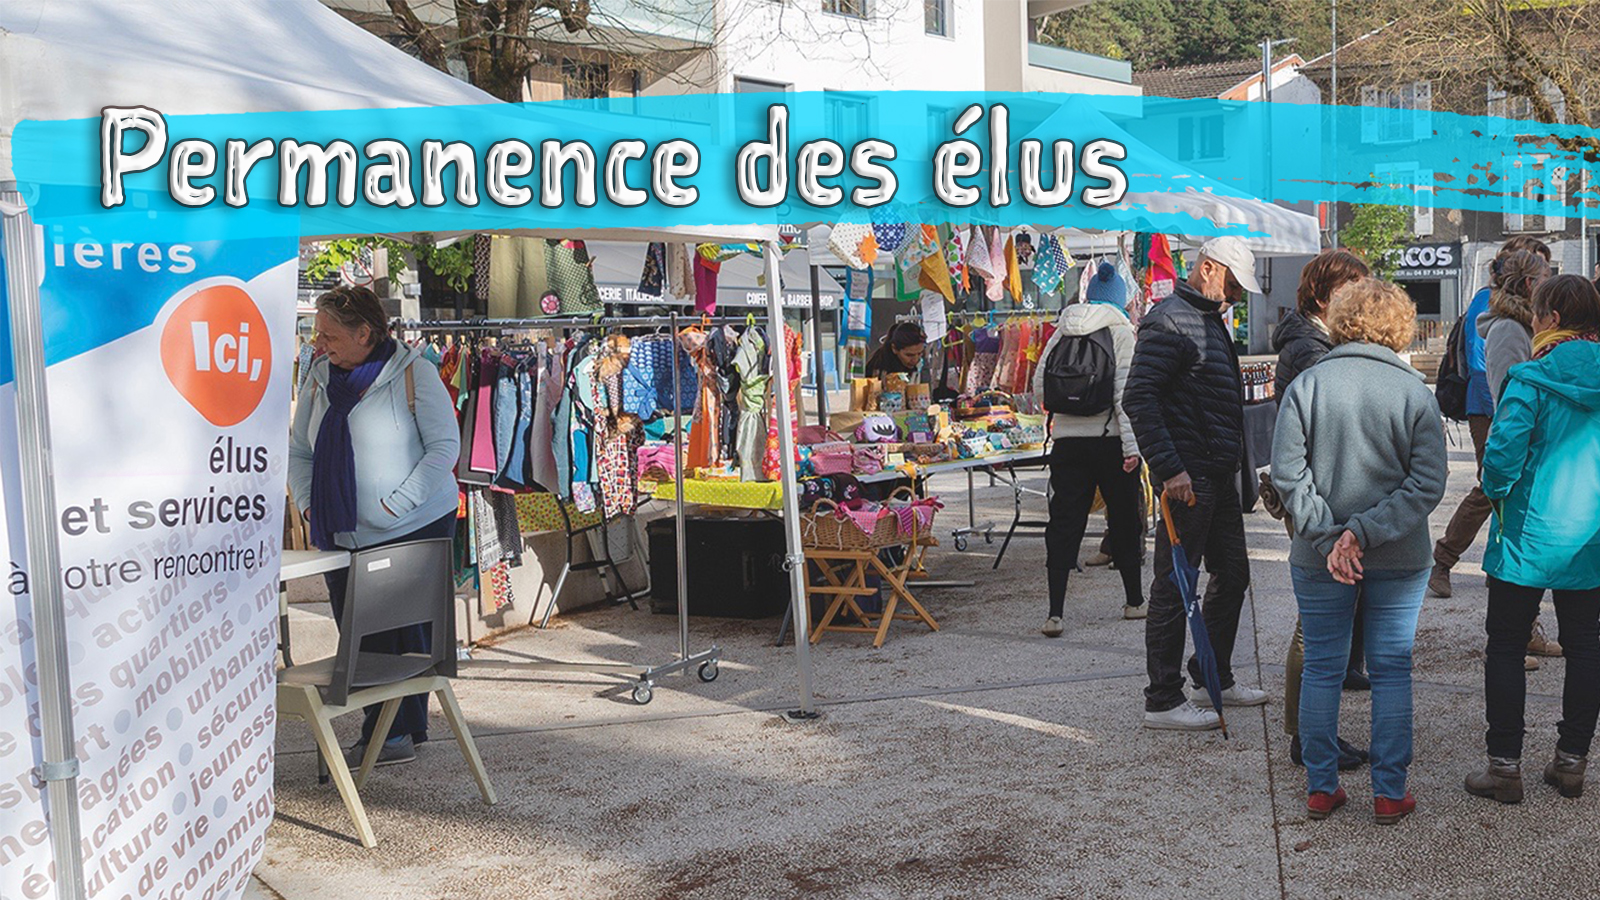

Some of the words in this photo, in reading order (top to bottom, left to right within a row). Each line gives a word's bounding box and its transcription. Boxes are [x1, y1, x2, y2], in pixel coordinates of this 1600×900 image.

[746, 292, 769, 305] COIFF
[191, 322, 263, 382] Ici,
[209, 436, 269, 474] élus
[61, 498, 111, 536] et
[128, 486, 266, 530] services
[60, 558, 142, 591] otre
[109, 580, 228, 690] quartiers
[0, 723, 110, 810] sprt
[135, 610, 235, 718] mobilité
[84, 811, 168, 899] ulture
[138, 855, 168, 898] de
[171, 814, 209, 860] vie
